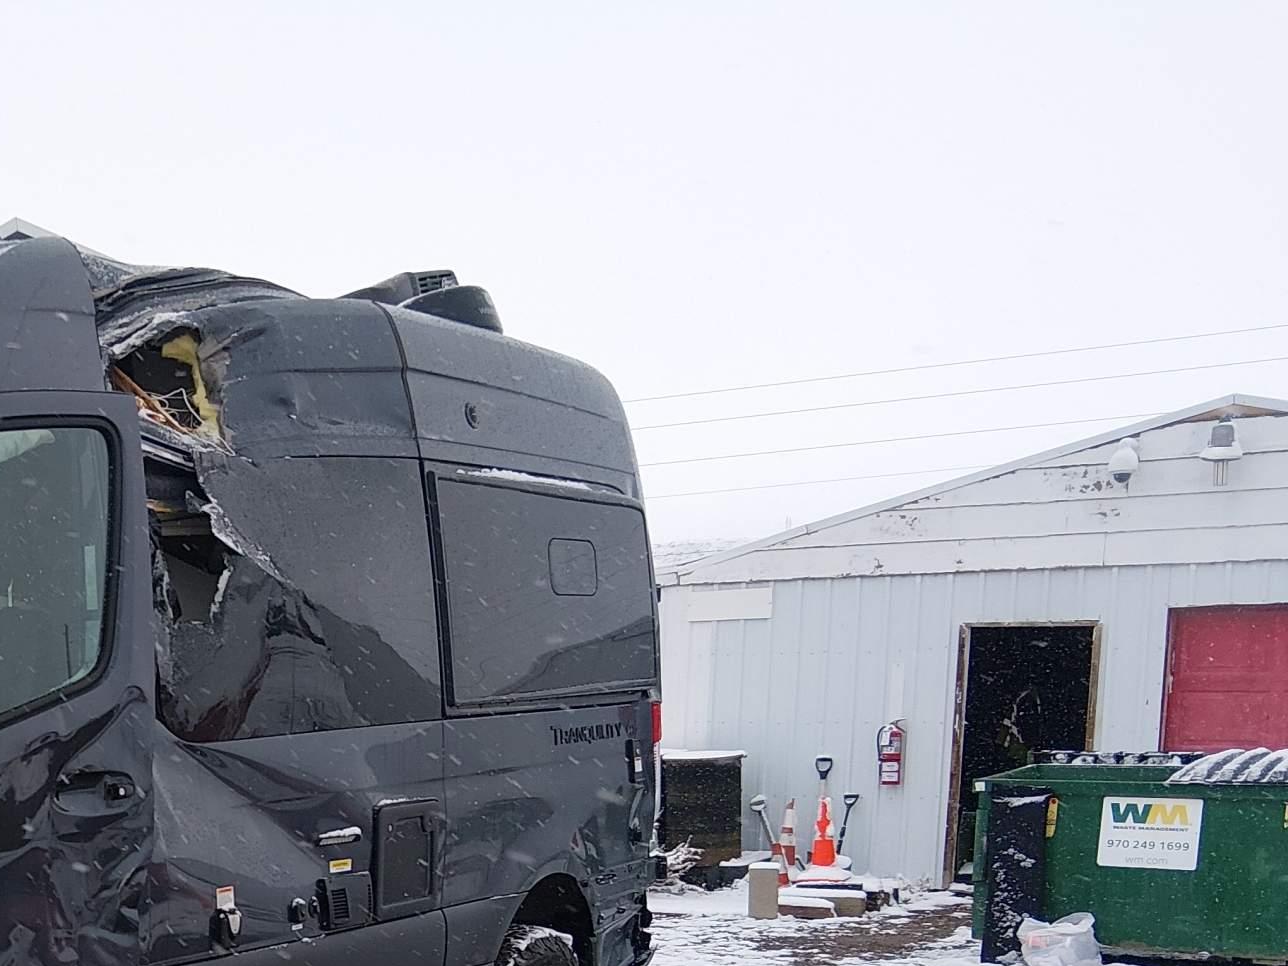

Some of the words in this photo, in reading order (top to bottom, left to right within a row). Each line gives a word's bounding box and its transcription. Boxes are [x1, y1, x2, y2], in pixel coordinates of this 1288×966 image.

[1111, 803, 1190, 826] WM
[1107, 839, 1130, 849] 970
[1132, 840, 1155, 850] 249
[1159, 841, 1190, 852] 1699
